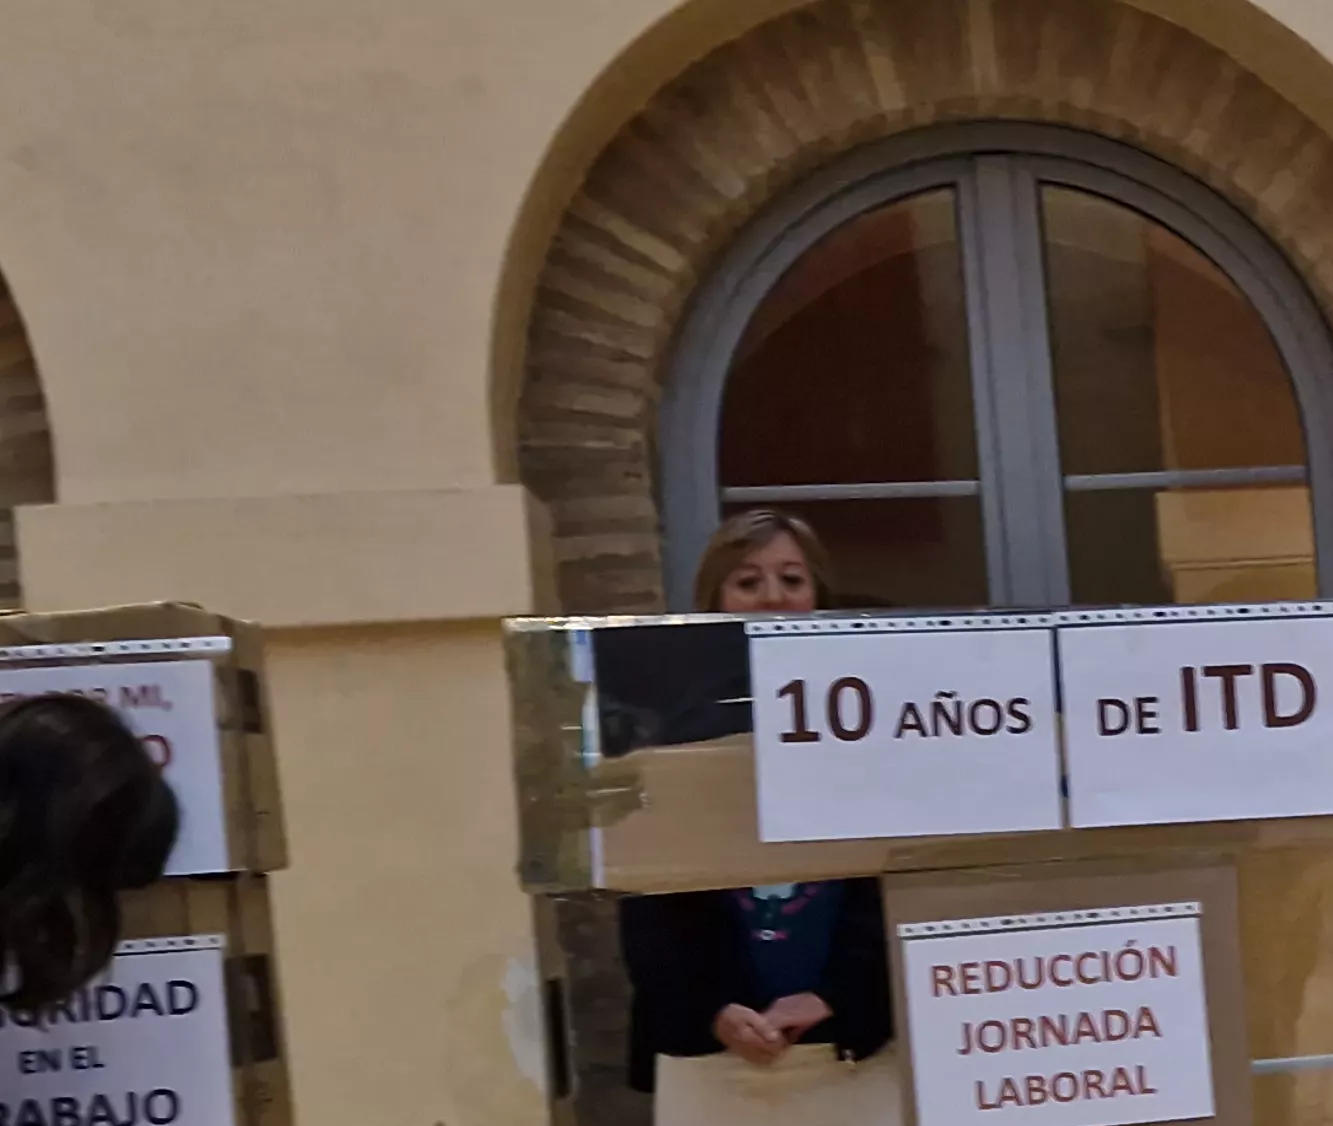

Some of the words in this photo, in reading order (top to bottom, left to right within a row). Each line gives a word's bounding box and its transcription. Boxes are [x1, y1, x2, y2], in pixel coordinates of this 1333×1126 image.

[778, 675, 874, 744] 10
[894, 690, 1032, 740] AÑOS
[1099, 696, 1160, 738] DE
[1179, 662, 1316, 733] ITD
[930, 939, 1179, 998] REDUCCIÓN
[956, 1006, 1163, 1055] JORNADA
[18, 1050, 61, 1075] EN
[70, 1046, 105, 1071] EL
[975, 1065, 1159, 1110] LABORAL
